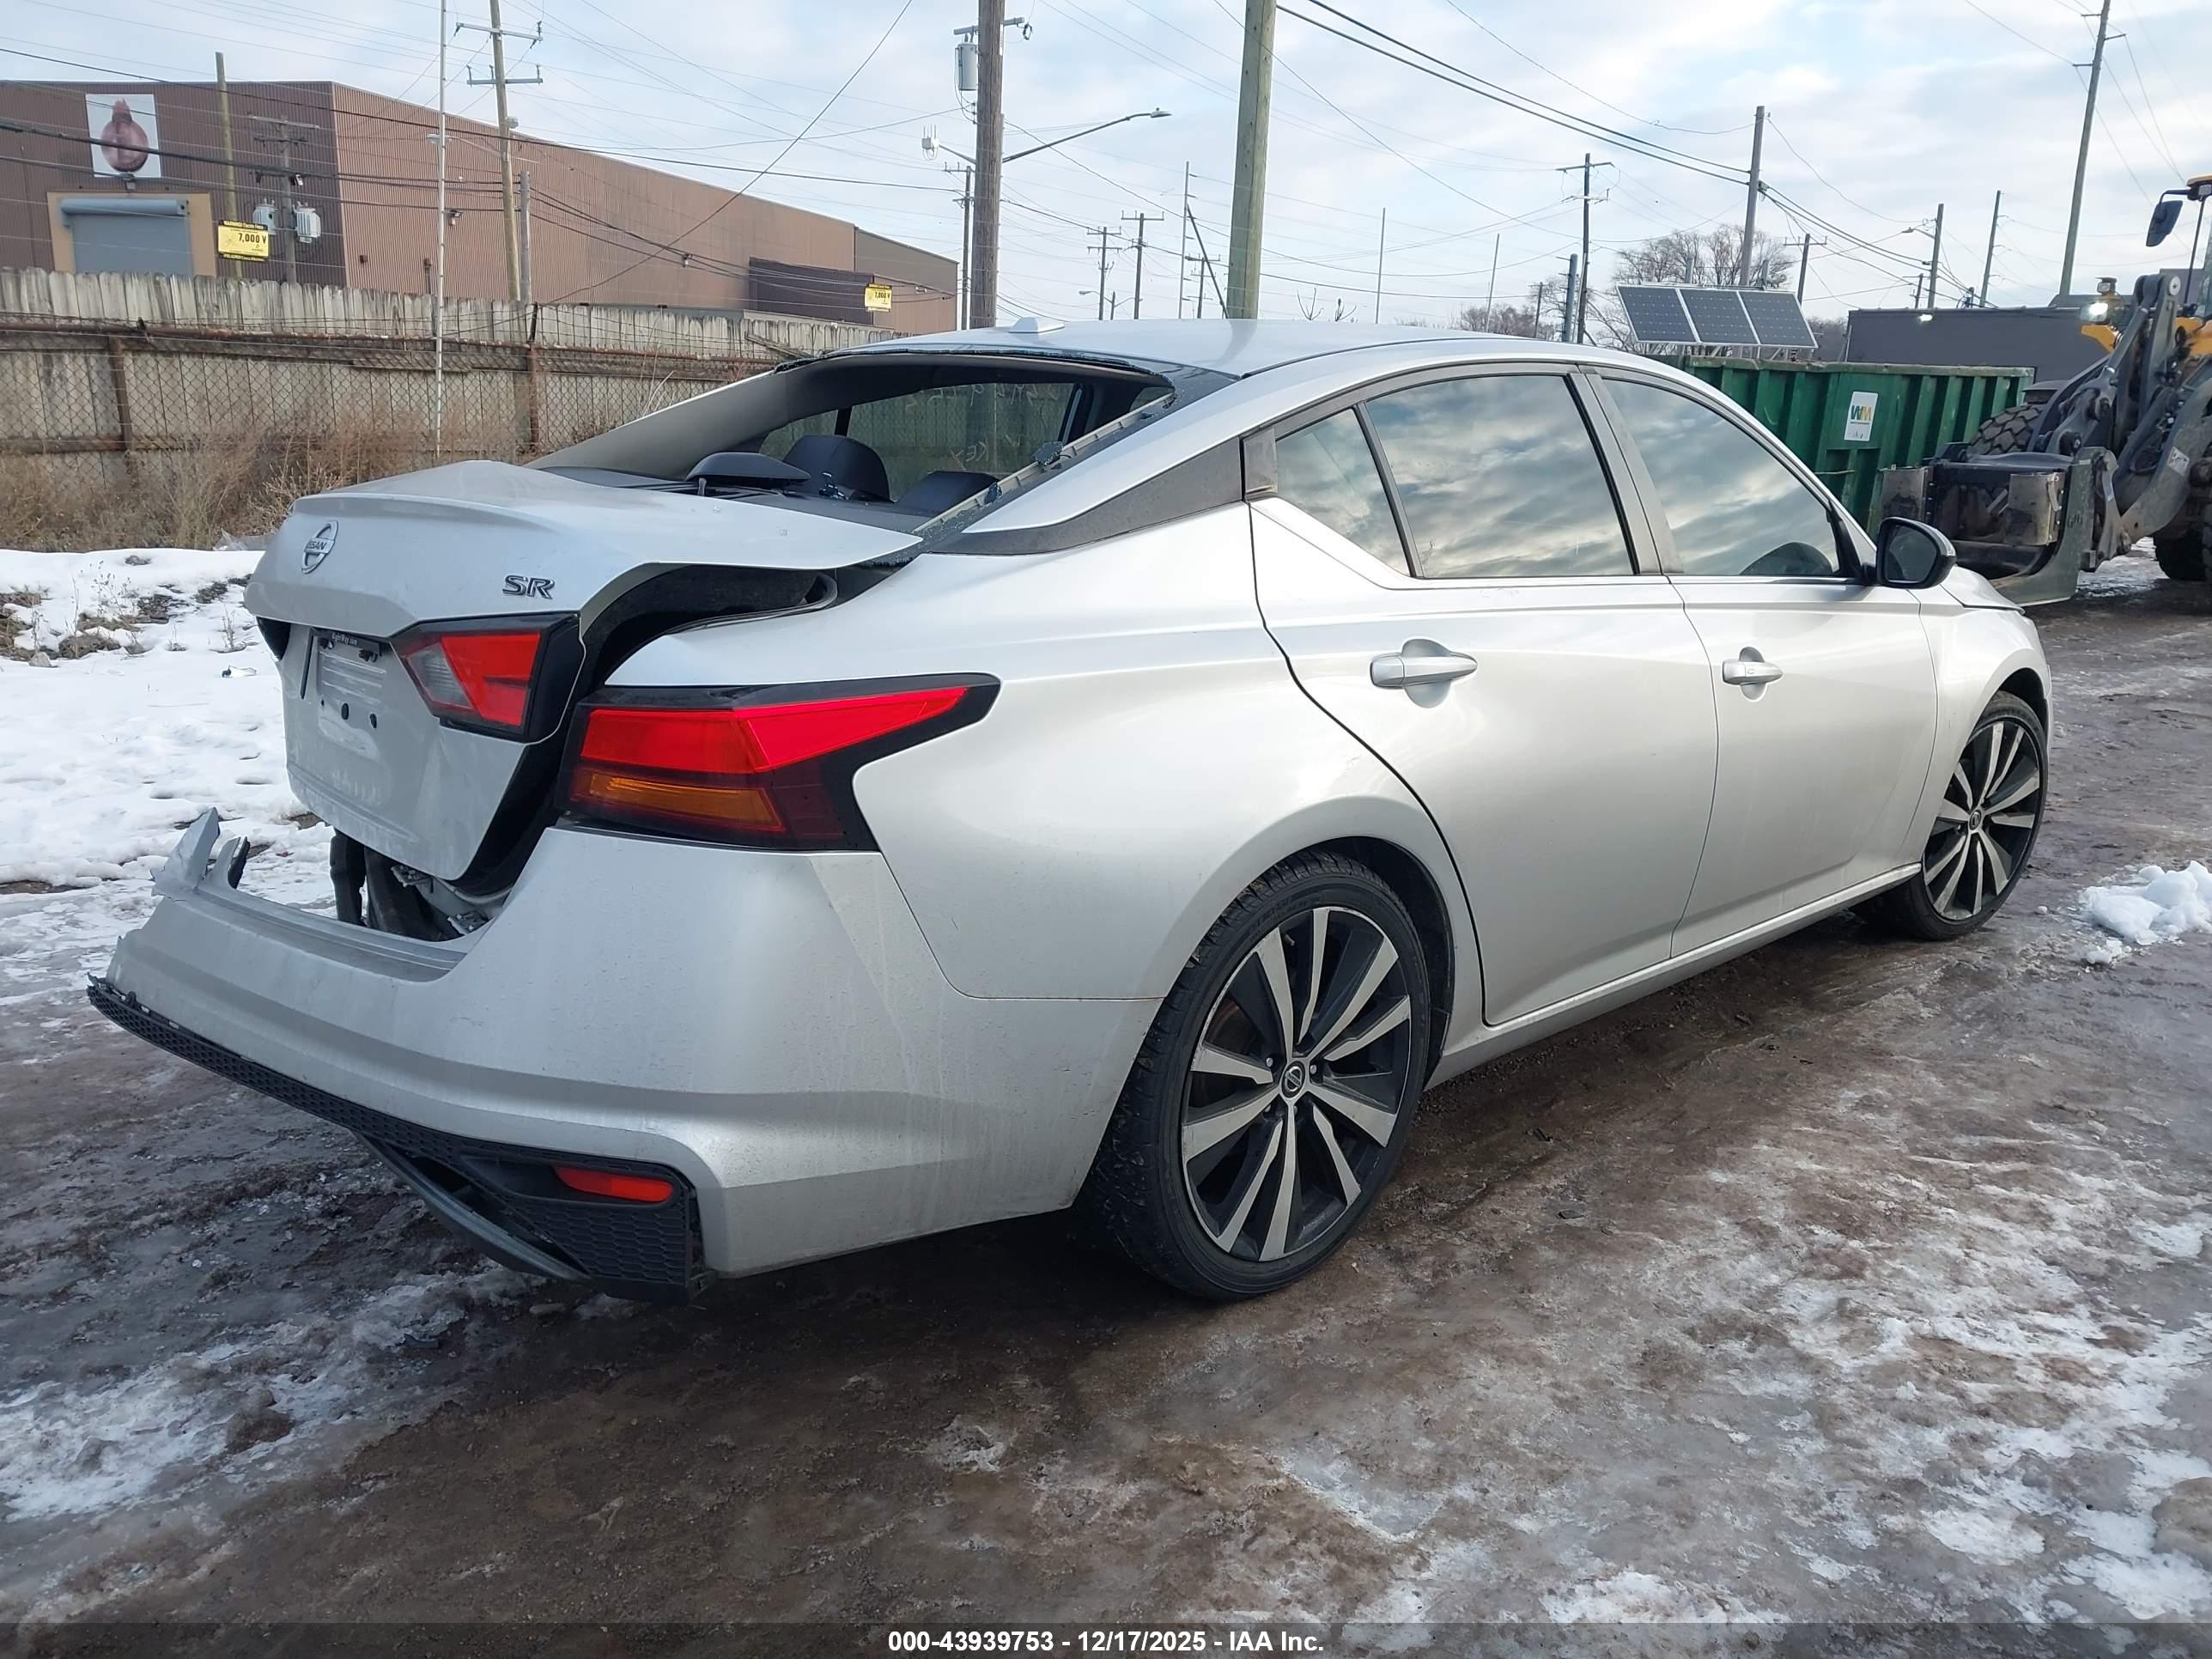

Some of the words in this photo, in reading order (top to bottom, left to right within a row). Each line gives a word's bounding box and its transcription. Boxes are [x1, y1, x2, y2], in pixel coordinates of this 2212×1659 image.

[239, 233, 260, 243] 7,000
[262, 235, 267, 245] V
[1850, 404, 1872, 422] WM
[501, 574, 556, 600] SR
